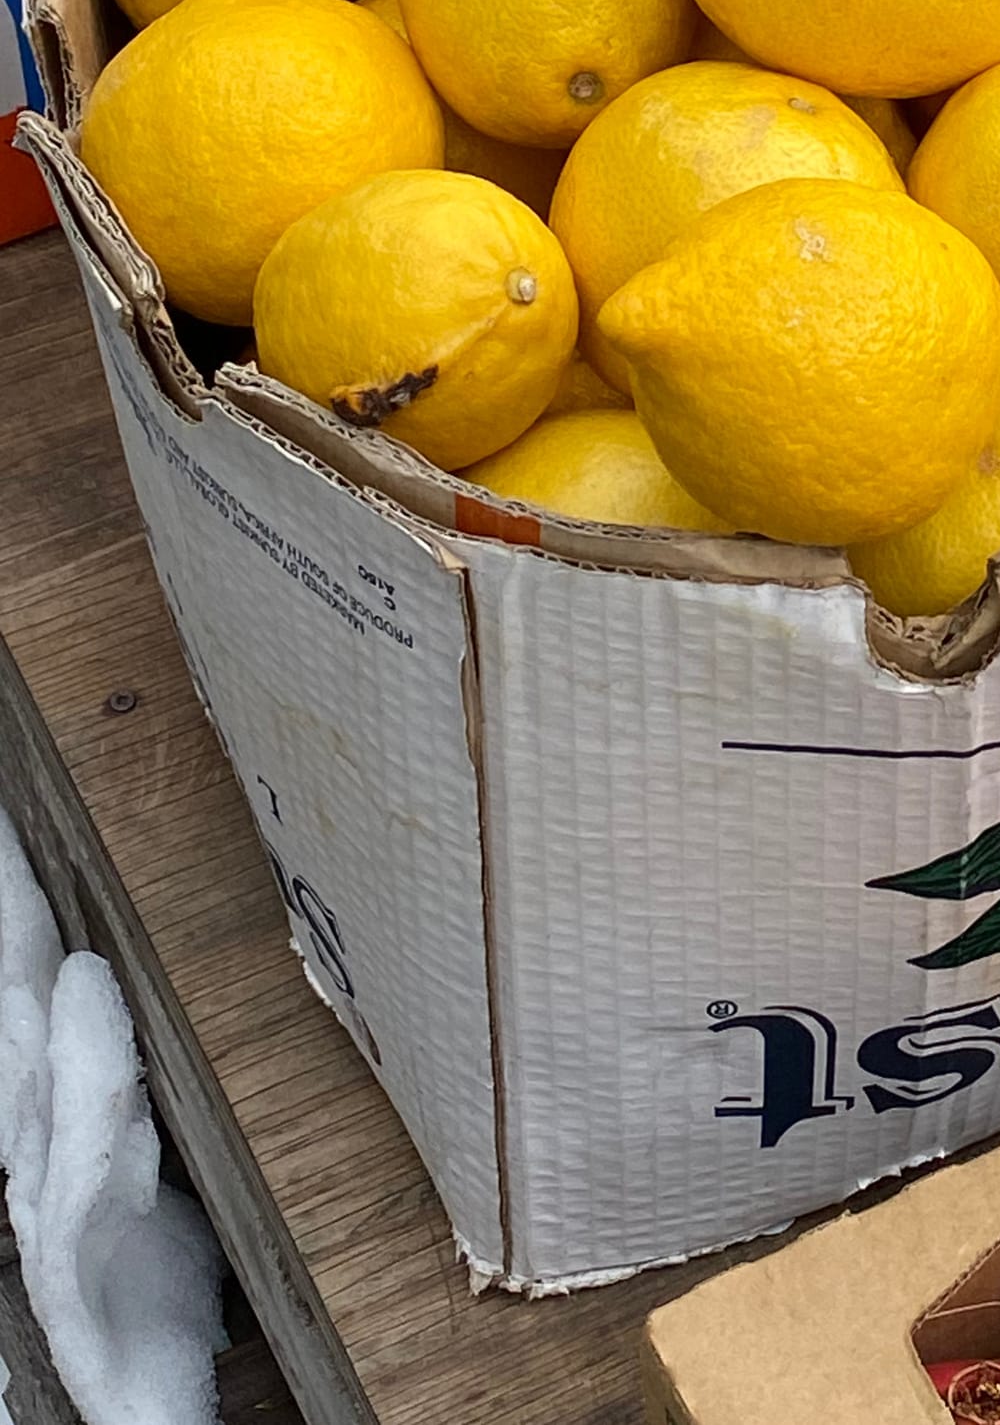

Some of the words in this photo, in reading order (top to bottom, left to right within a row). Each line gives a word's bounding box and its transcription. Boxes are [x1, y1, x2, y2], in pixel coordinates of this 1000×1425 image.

[282, 558, 299, 579] BY
[287, 542, 330, 587] SOUTH
[332, 582, 348, 602] OF
[350, 595, 413, 649] PRODUCE
